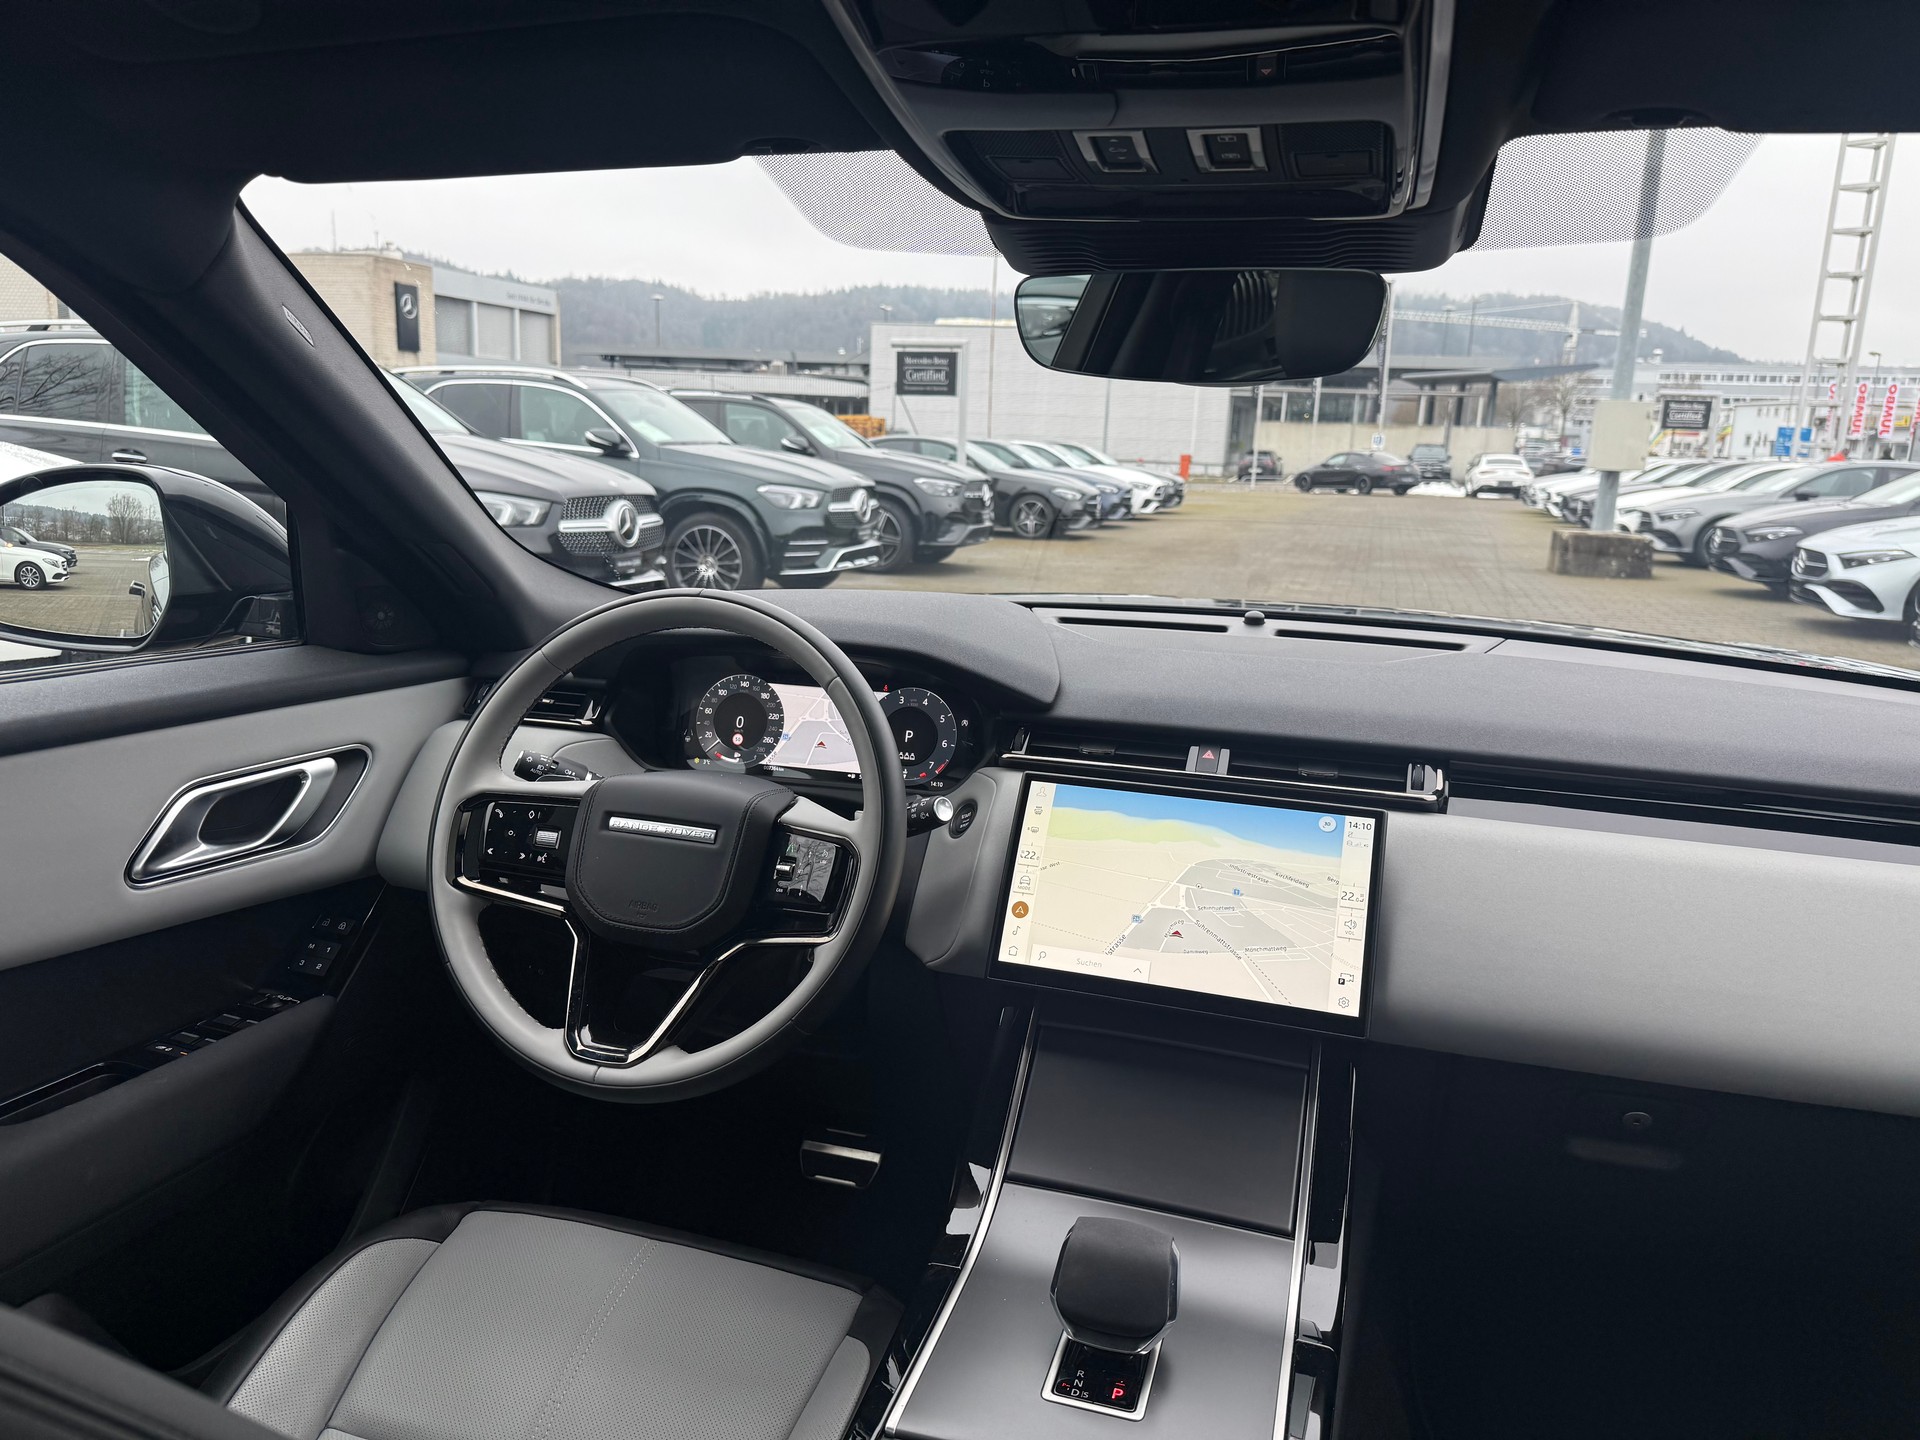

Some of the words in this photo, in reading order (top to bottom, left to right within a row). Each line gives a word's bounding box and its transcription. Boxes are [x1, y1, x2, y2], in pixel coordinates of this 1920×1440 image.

[905, 369, 946, 381] Certified
[1850, 383, 1867, 435] JUMBO
[1879, 383, 1897, 436] JUMBO
[899, 696, 905, 704] 3
[922, 698, 928, 706] 4
[736, 715, 744, 729] 0
[939, 715, 945, 723] 5
[904, 730, 914, 742] P
[941, 739, 948, 748] 6
[928, 761, 935, 769] 7
[611, 820, 660, 832] RANGE
[664, 828, 714, 839] ROVER
[1348, 821, 1372, 831] 14:10
[1229, 863, 1270, 884] Industriestrasse
[1275, 872, 1310, 888] Kirchfeldweg
[1326, 875, 1340, 886] Berg
[1195, 919, 1242, 960] Suhrenmattstrasse
[1076, 957, 1103, 968] Suchen
[1077, 1370, 1084, 1378] R
[1073, 1379, 1083, 1387] N
[1070, 1388, 1079, 1396] D
[1111, 1388, 1124, 1399] P
